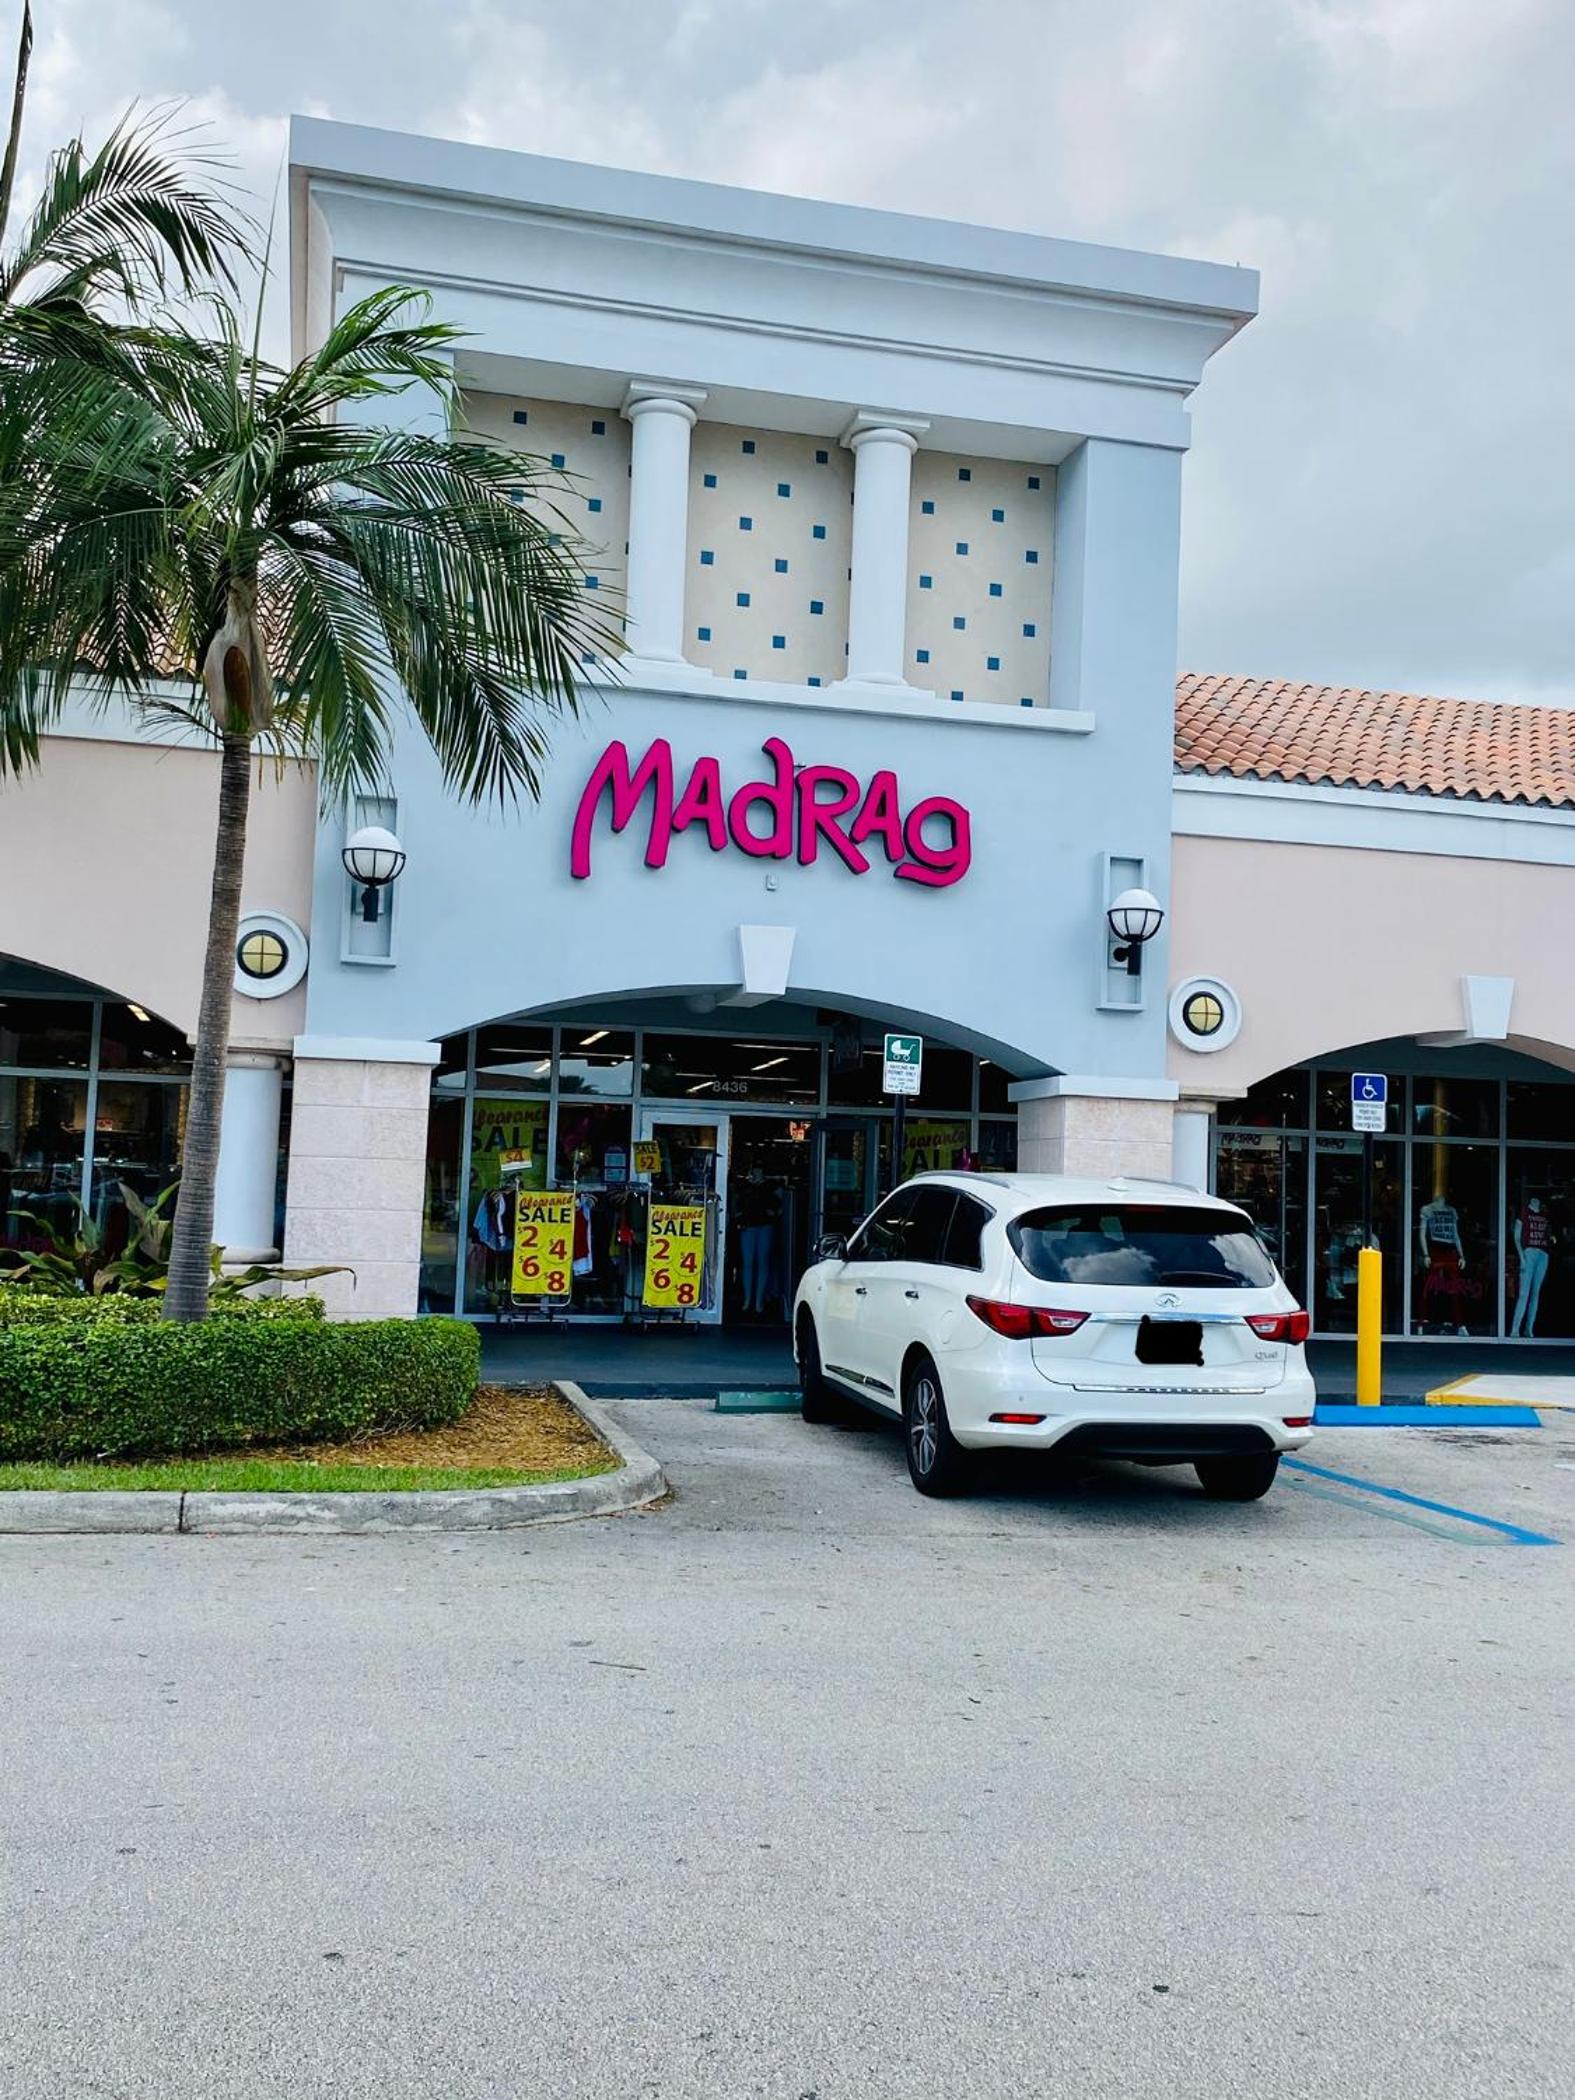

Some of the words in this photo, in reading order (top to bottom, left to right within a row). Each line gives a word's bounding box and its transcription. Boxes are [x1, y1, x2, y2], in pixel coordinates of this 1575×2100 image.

[712, 1080, 748, 1094] 8436
[518, 1206, 571, 1224] SALE
[651, 1219, 702, 1237] SALE
